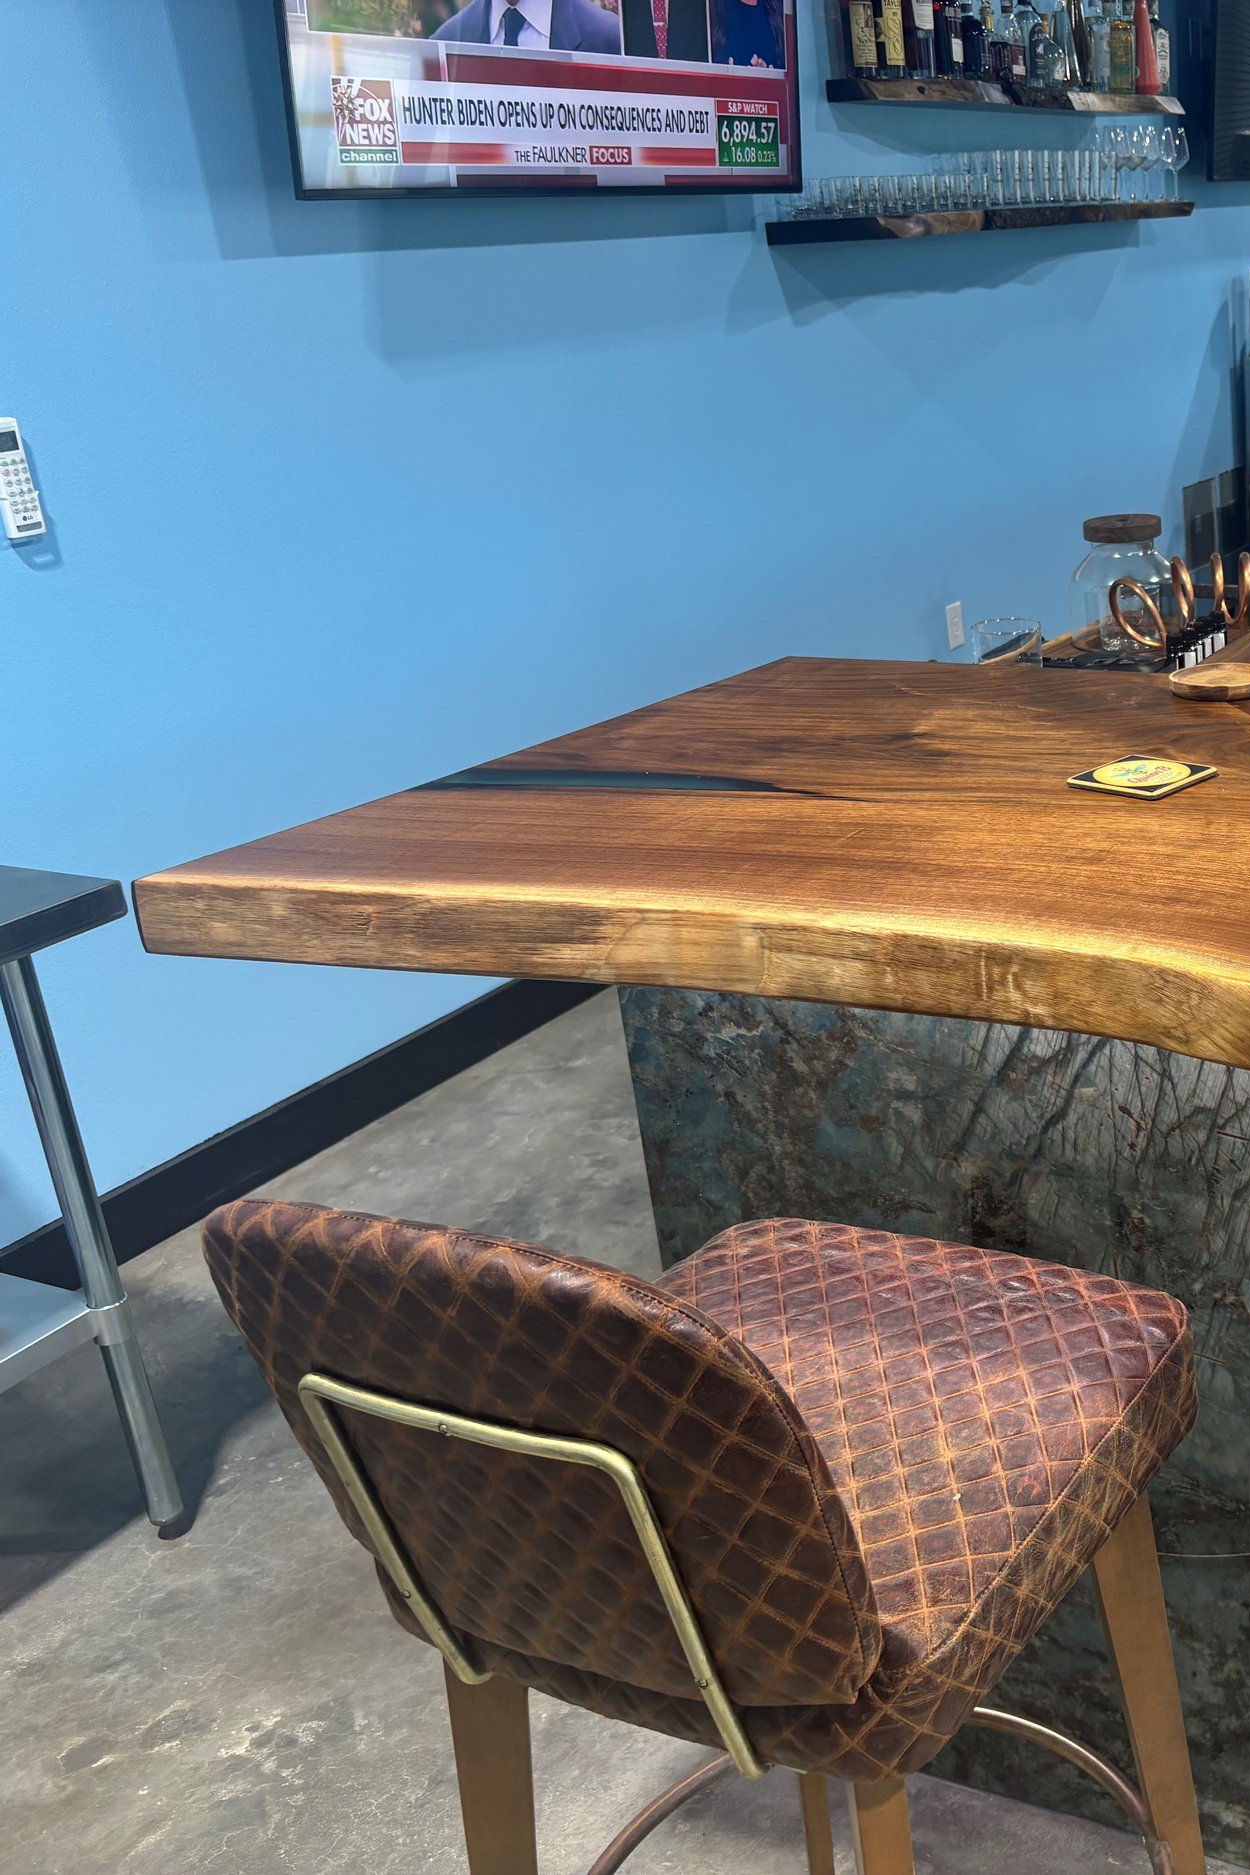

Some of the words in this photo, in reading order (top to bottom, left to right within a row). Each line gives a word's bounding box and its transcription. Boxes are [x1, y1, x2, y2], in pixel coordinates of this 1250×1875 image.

[354, 98, 392, 122] FOX
[402, 97, 455, 125] HUNTER
[457, 99, 495, 127] BIDEN
[497, 101, 537, 128] OPENS
[540, 102, 555, 129] UP
[558, 103, 577, 130] ON
[579, 105, 662, 132] CONSEQUENCES
[664, 109, 686, 133] AND
[689, 111, 709, 134] DEBT
[728, 102, 742, 112] S&P
[743, 103, 768, 114] WATCH
[345, 123, 396, 145] NEWS
[721, 120, 775, 146] 6,894.57
[341, 151, 396, 162] channel
[515, 150, 532, 162] THE
[532, 147, 588, 163] FAULKNER
[592, 147, 629, 163] FOCUS
[731, 147, 757, 162] 16.08
[757, 150, 777, 162] 0.23%
